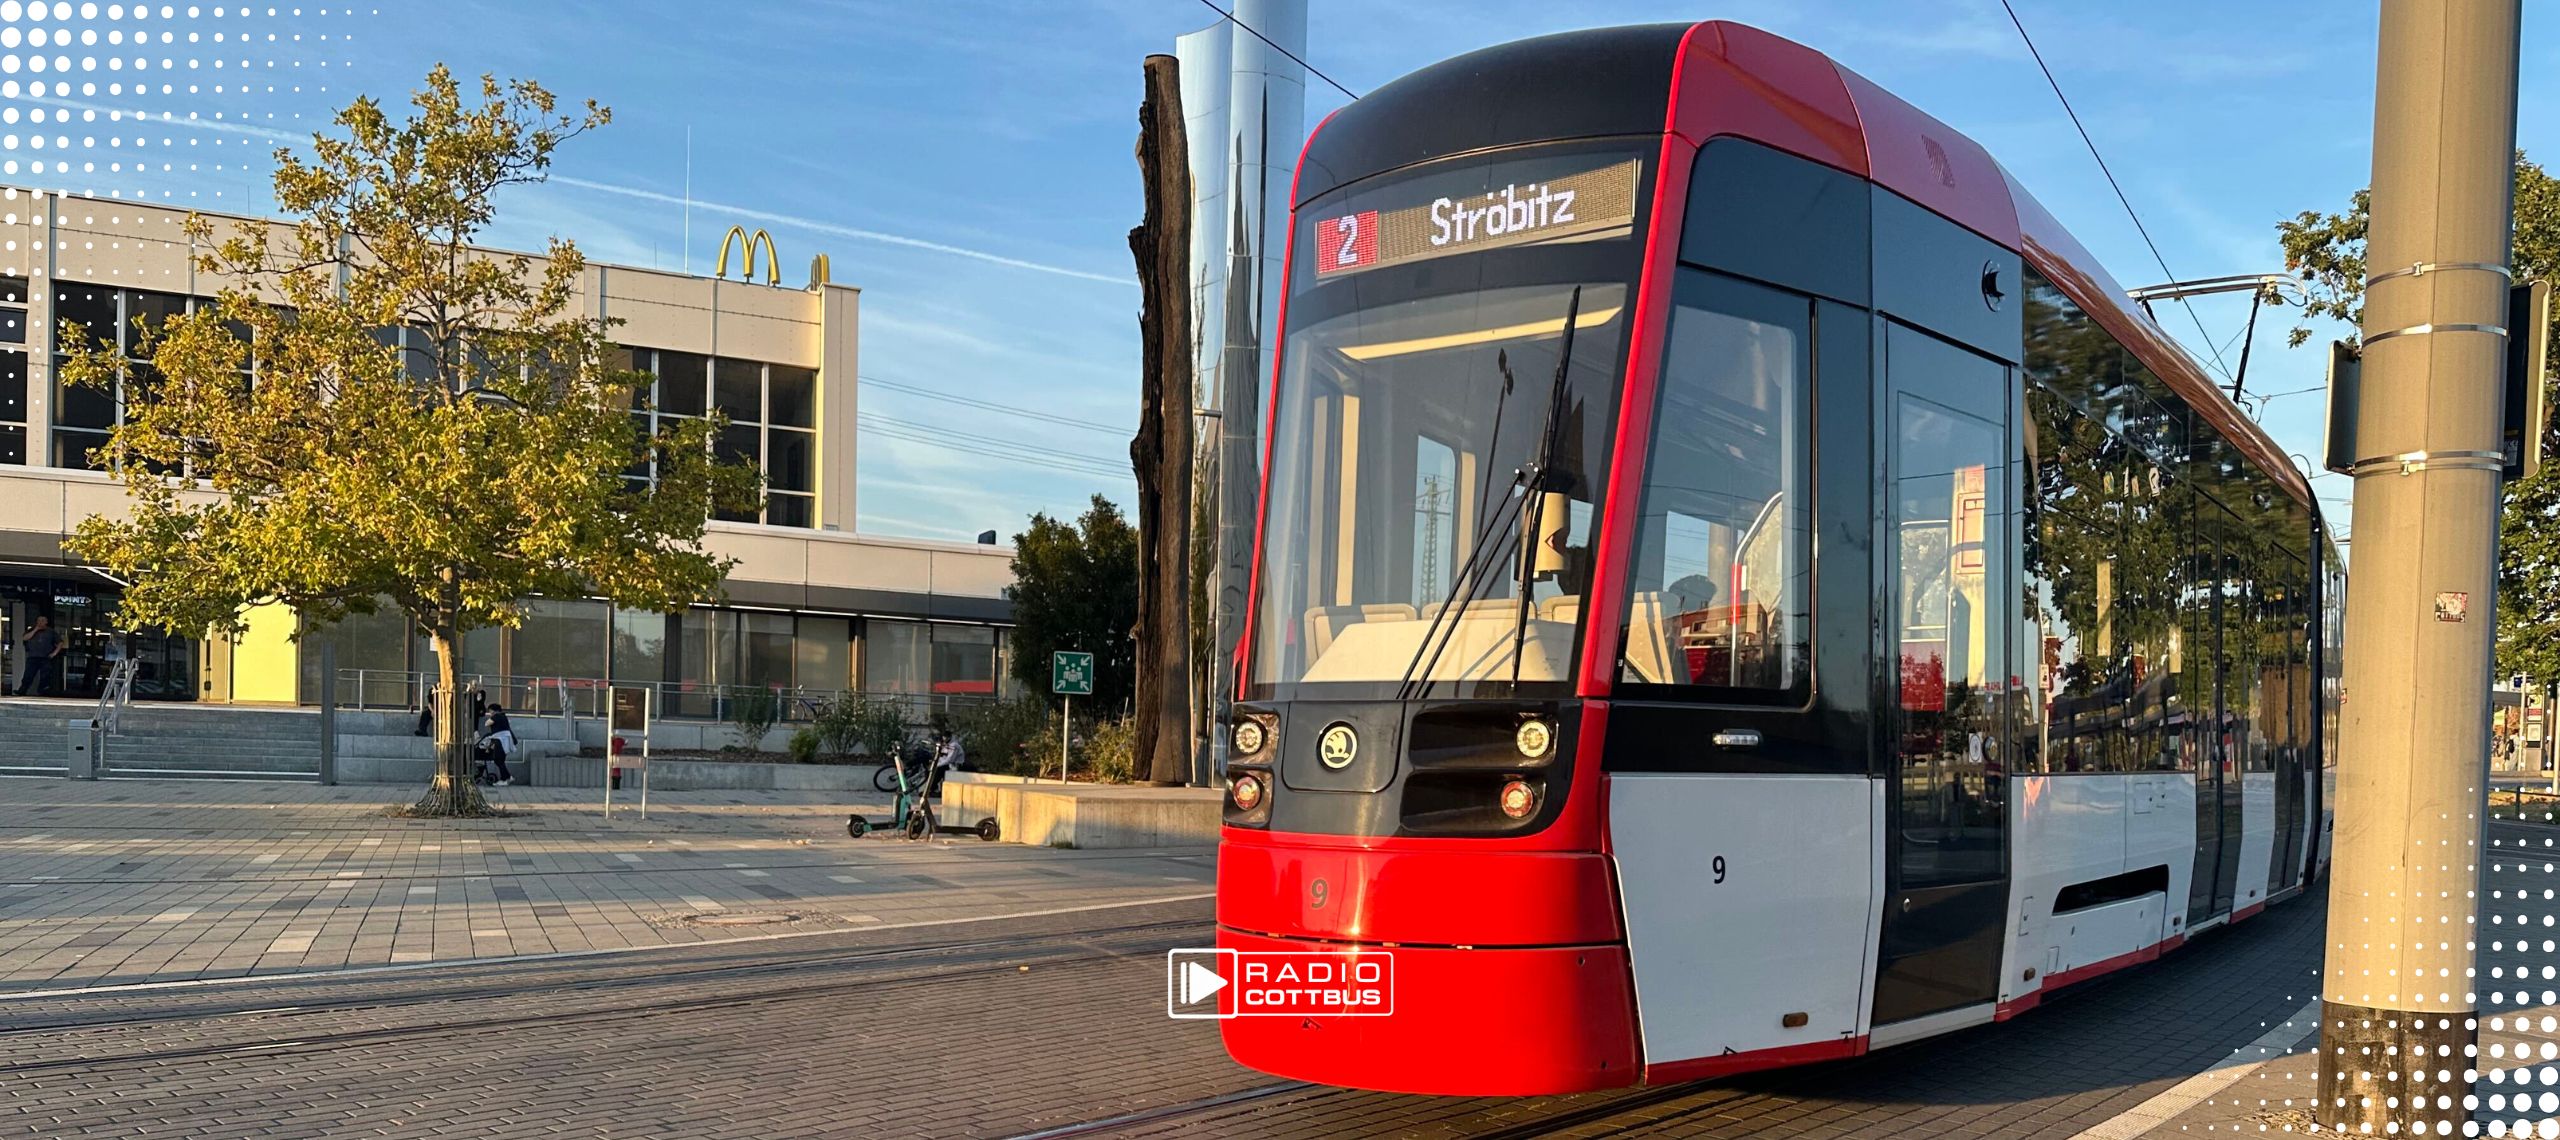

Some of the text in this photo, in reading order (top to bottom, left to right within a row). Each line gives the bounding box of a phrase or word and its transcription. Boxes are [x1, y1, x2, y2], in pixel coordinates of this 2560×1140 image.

[1337, 183, 1576, 266] 2 Ströbitz
[1711, 855, 1727, 885] 9
[1311, 878, 1329, 910] 9
